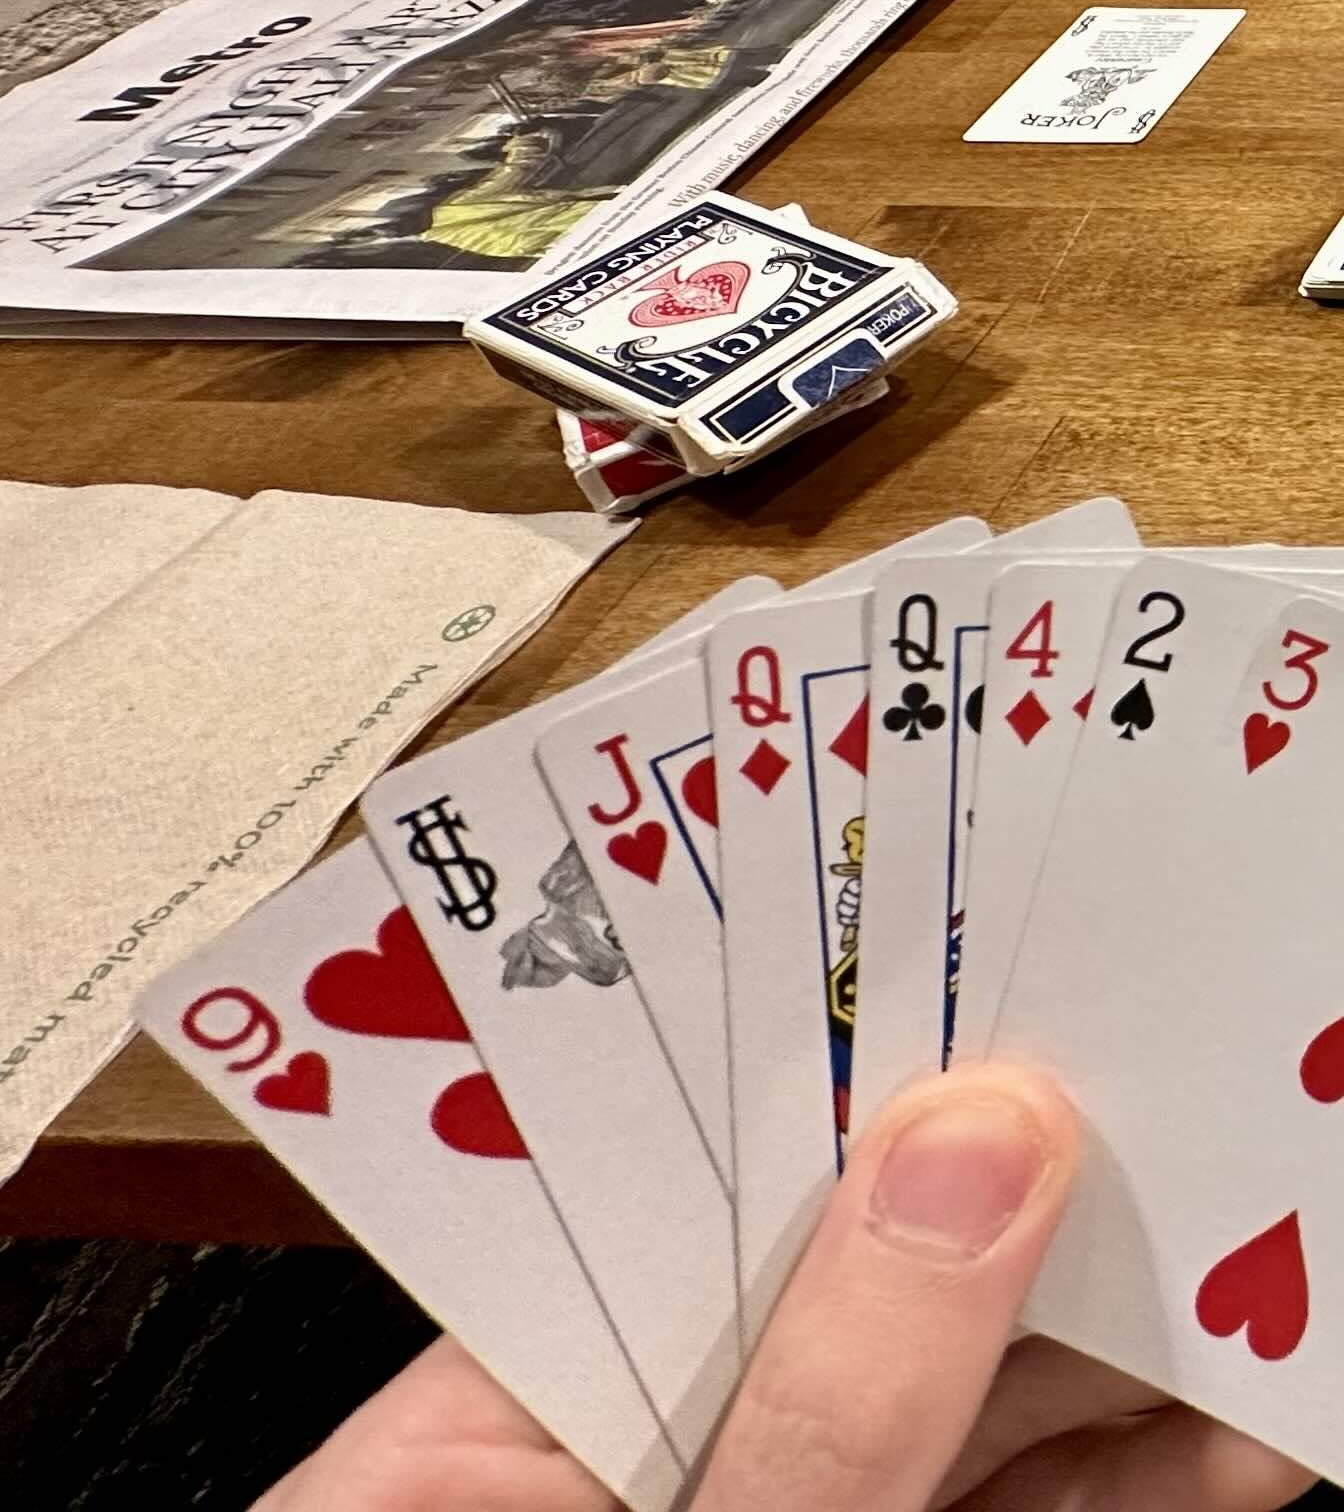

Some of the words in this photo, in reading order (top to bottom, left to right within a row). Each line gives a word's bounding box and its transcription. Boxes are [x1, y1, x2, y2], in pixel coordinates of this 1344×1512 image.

[77, 16, 313, 122] Metro
[0, 153, 178, 232] FIRST
[163, 52, 341, 145] NIGHT
[703, 152, 744, 185] music,
[733, 115, 787, 154] dancing,
[781, 96, 802, 116] and
[1020, 106, 1128, 130] JOKER
[31, 216, 127, 254] AT
[607, 214, 714, 272] PLAYING
[516, 270, 609, 322] CARDS
[637, 262, 856, 388] BICYCLE
[867, 301, 913, 337] POKER
[891, 592, 945, 672] Q
[1004, 599, 1061, 677] 4
[1123, 591, 1186, 671] 2
[1261, 628, 1330, 710] 3
[357, 663, 439, 732] Made
[730, 645, 792, 727] Q
[294, 736, 360, 791] with
[587, 733, 645, 826] J
[206, 799, 298, 873] 100%
[66, 879, 208, 1003] recycled
[181, 987, 282, 1073] 9
